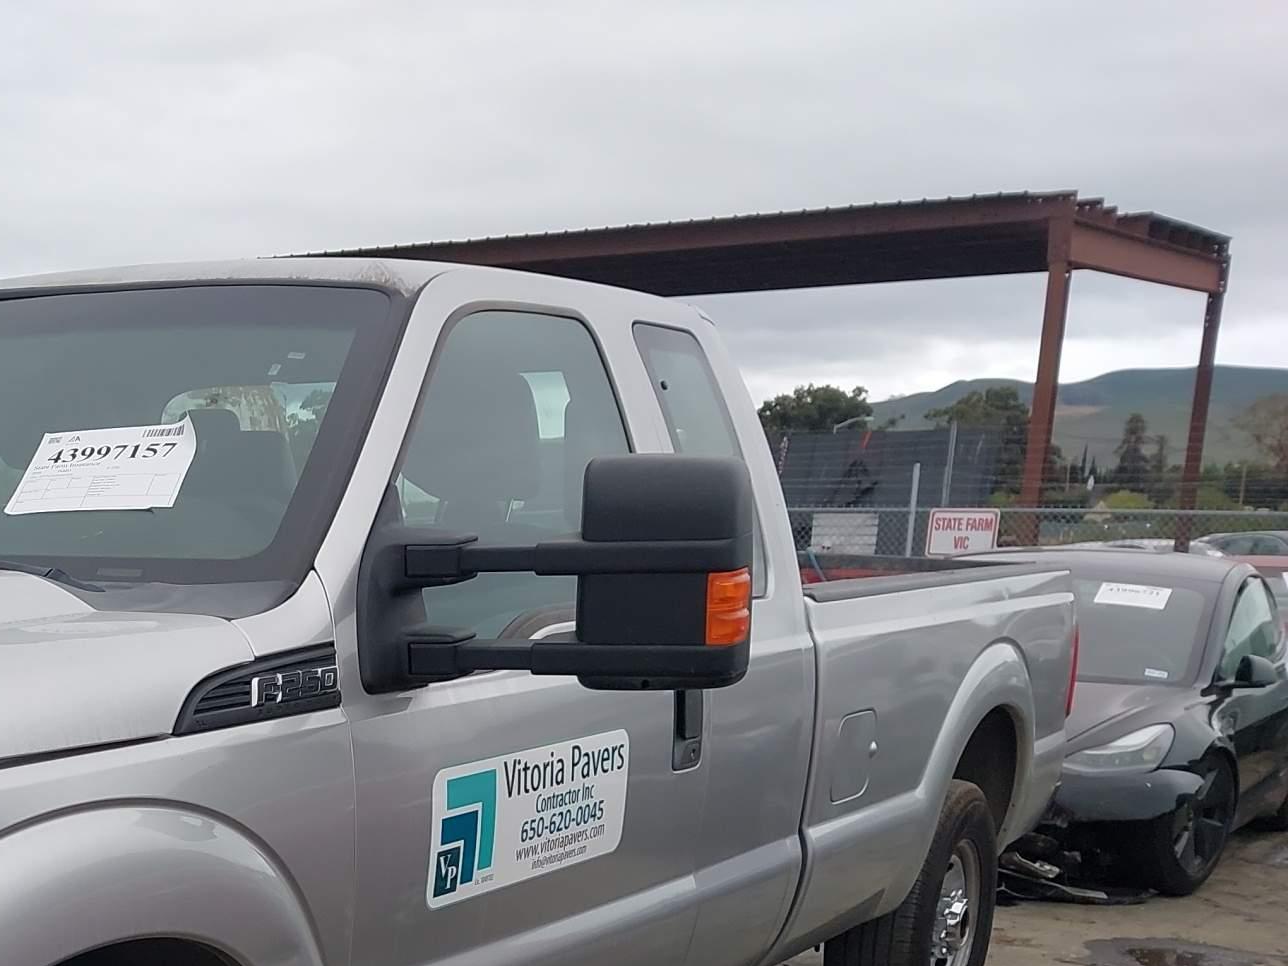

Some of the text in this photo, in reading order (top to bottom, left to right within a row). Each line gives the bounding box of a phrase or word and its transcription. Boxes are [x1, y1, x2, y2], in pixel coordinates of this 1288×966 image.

[47, 443, 177, 464] 43997157
[934, 517, 994, 531] STATE FARM
[953, 535, 970, 550] VIC
[504, 743, 625, 798] Vitoria Pavers
[536, 782, 595, 814] Contractor Inc
[520, 800, 605, 842] 650-620-0045
[515, 823, 605, 861] www.vitoriapavers.com
